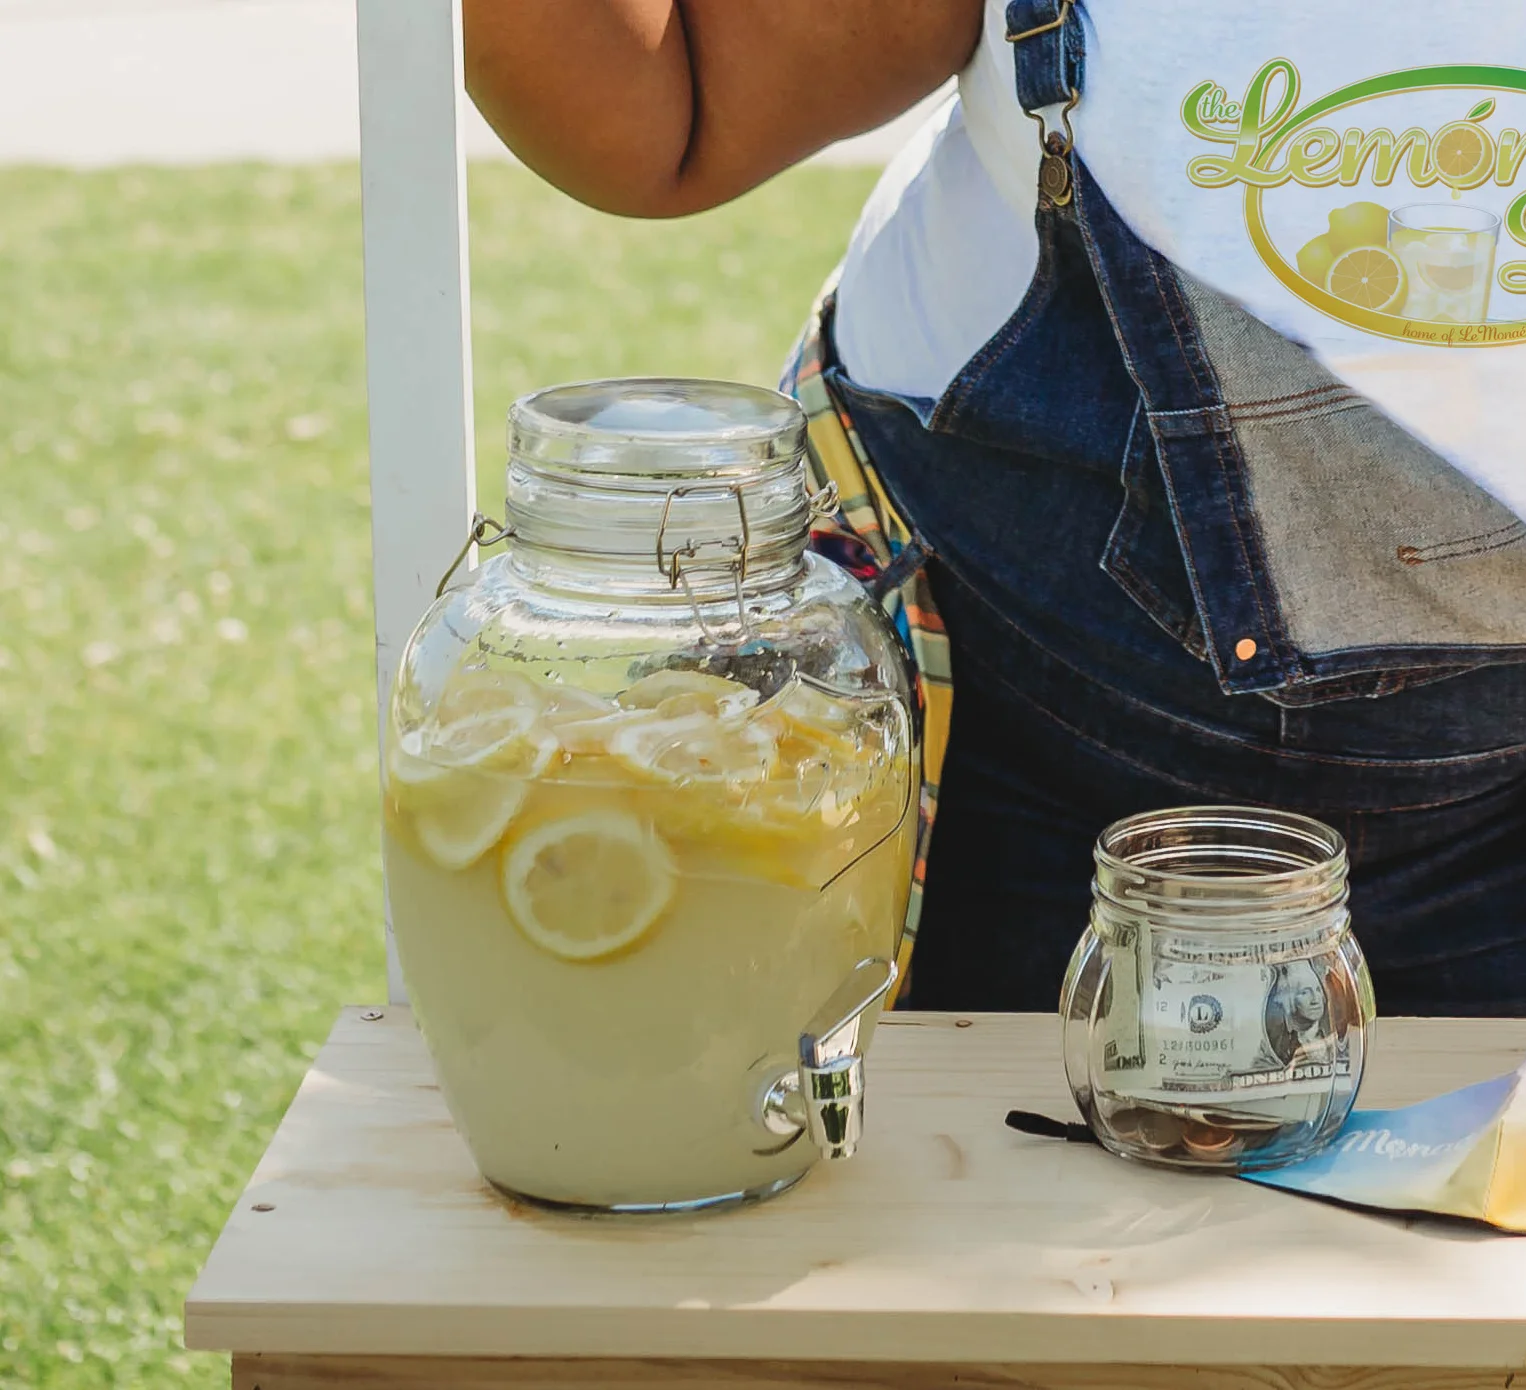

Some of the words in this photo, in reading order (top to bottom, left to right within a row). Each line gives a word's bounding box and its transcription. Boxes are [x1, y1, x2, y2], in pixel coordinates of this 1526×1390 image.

[1200, 88, 1241, 121] the
[1401, 320, 1437, 341] home
[1441, 327, 1455, 348] of
